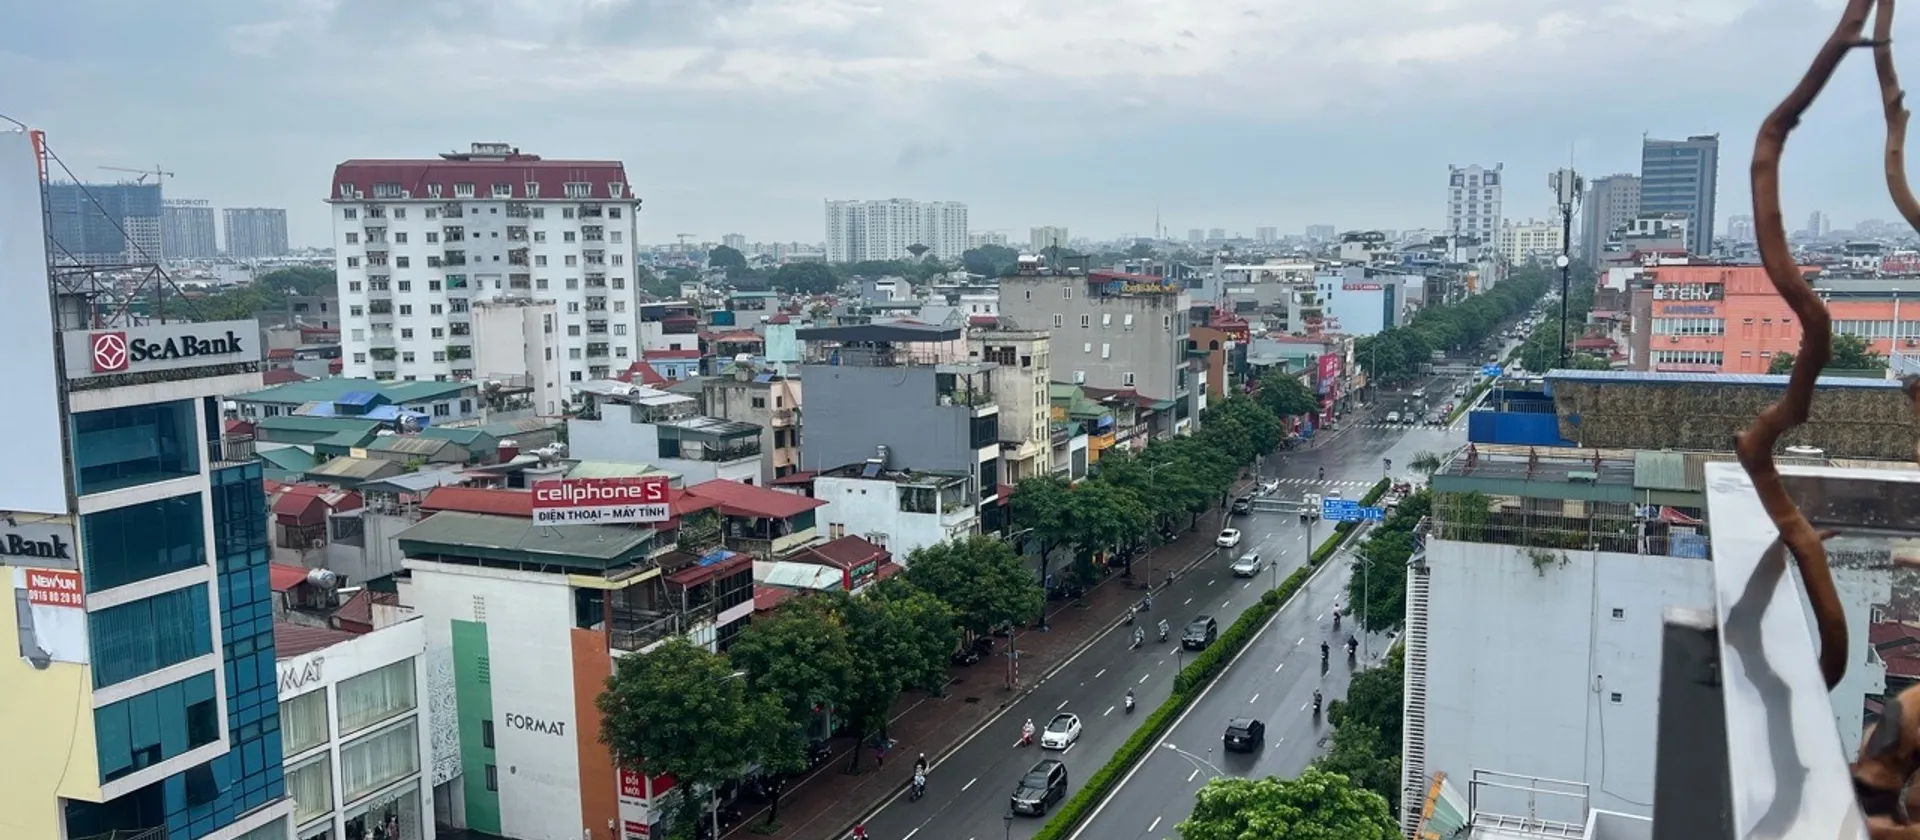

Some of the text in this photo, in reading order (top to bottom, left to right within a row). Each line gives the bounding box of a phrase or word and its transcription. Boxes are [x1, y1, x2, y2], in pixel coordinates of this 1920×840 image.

[130, 331, 244, 362] SeABank
[537, 483, 641, 505] cellphone
[538, 509, 565, 523] ĐIỆN
[567, 510, 601, 521] THOẠI
[613, 506, 636, 517] MÁY
[639, 505, 665, 517] TÍNH
[505, 712, 565, 737] FORMAT
